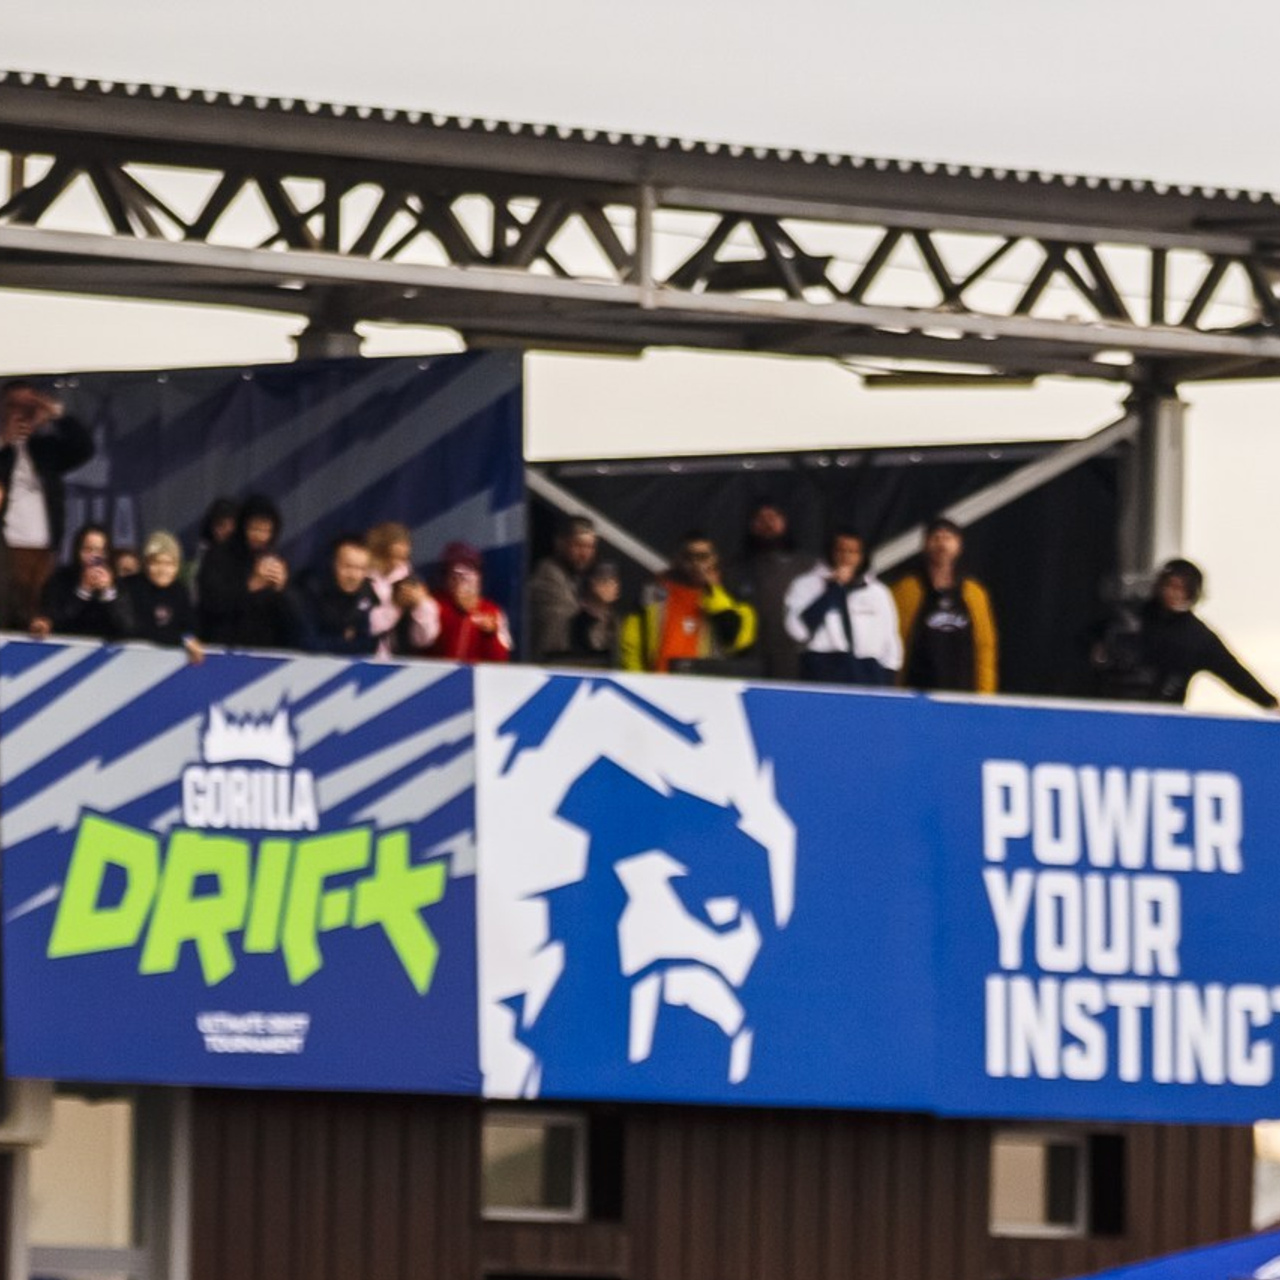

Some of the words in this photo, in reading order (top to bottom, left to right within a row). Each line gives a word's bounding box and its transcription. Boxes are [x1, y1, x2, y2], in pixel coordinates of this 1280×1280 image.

[181, 766, 319, 831] GORILLA
[982, 759, 1243, 874] POWER
[47, 814, 448, 996] DRIFT
[982, 867, 1181, 977] YOUR
